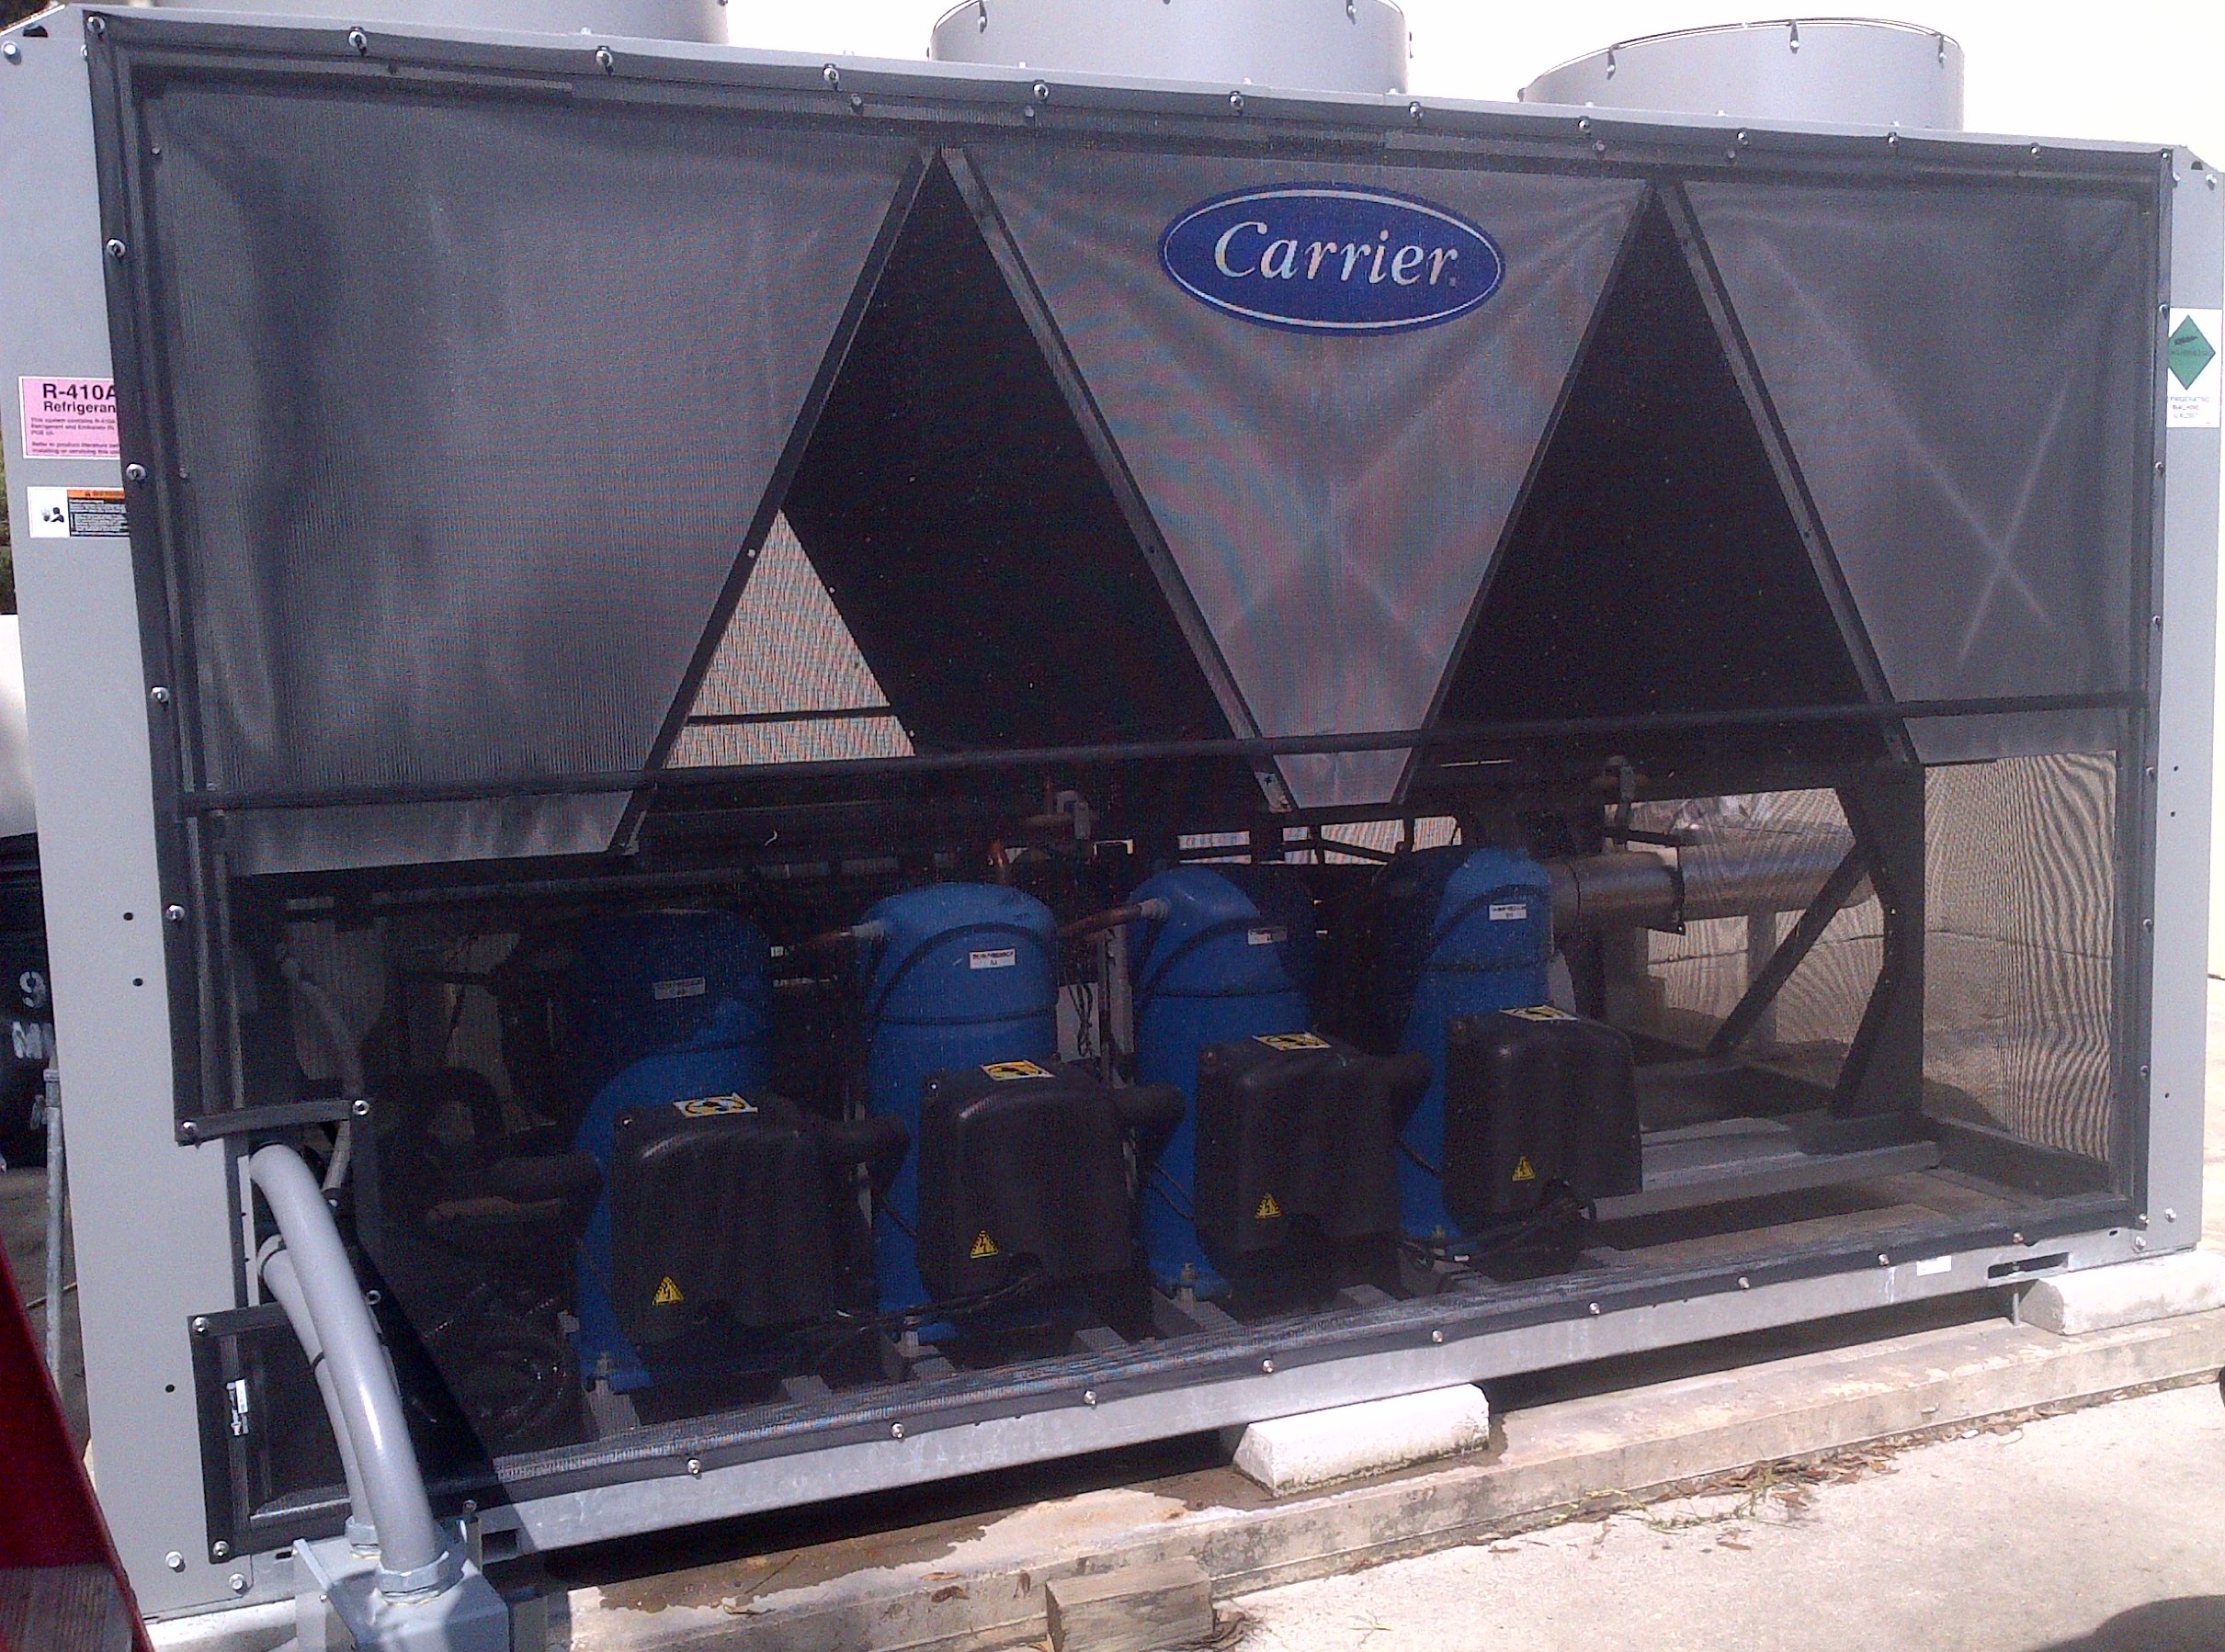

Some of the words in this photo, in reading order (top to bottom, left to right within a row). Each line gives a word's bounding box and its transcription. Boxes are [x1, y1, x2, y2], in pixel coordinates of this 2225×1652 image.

[1214, 221, 1458, 286] Carrier
[42, 383, 117, 401] R-410A
[43, 401, 117, 414] Refrigeran
[19, 971, 46, 1008] 9
